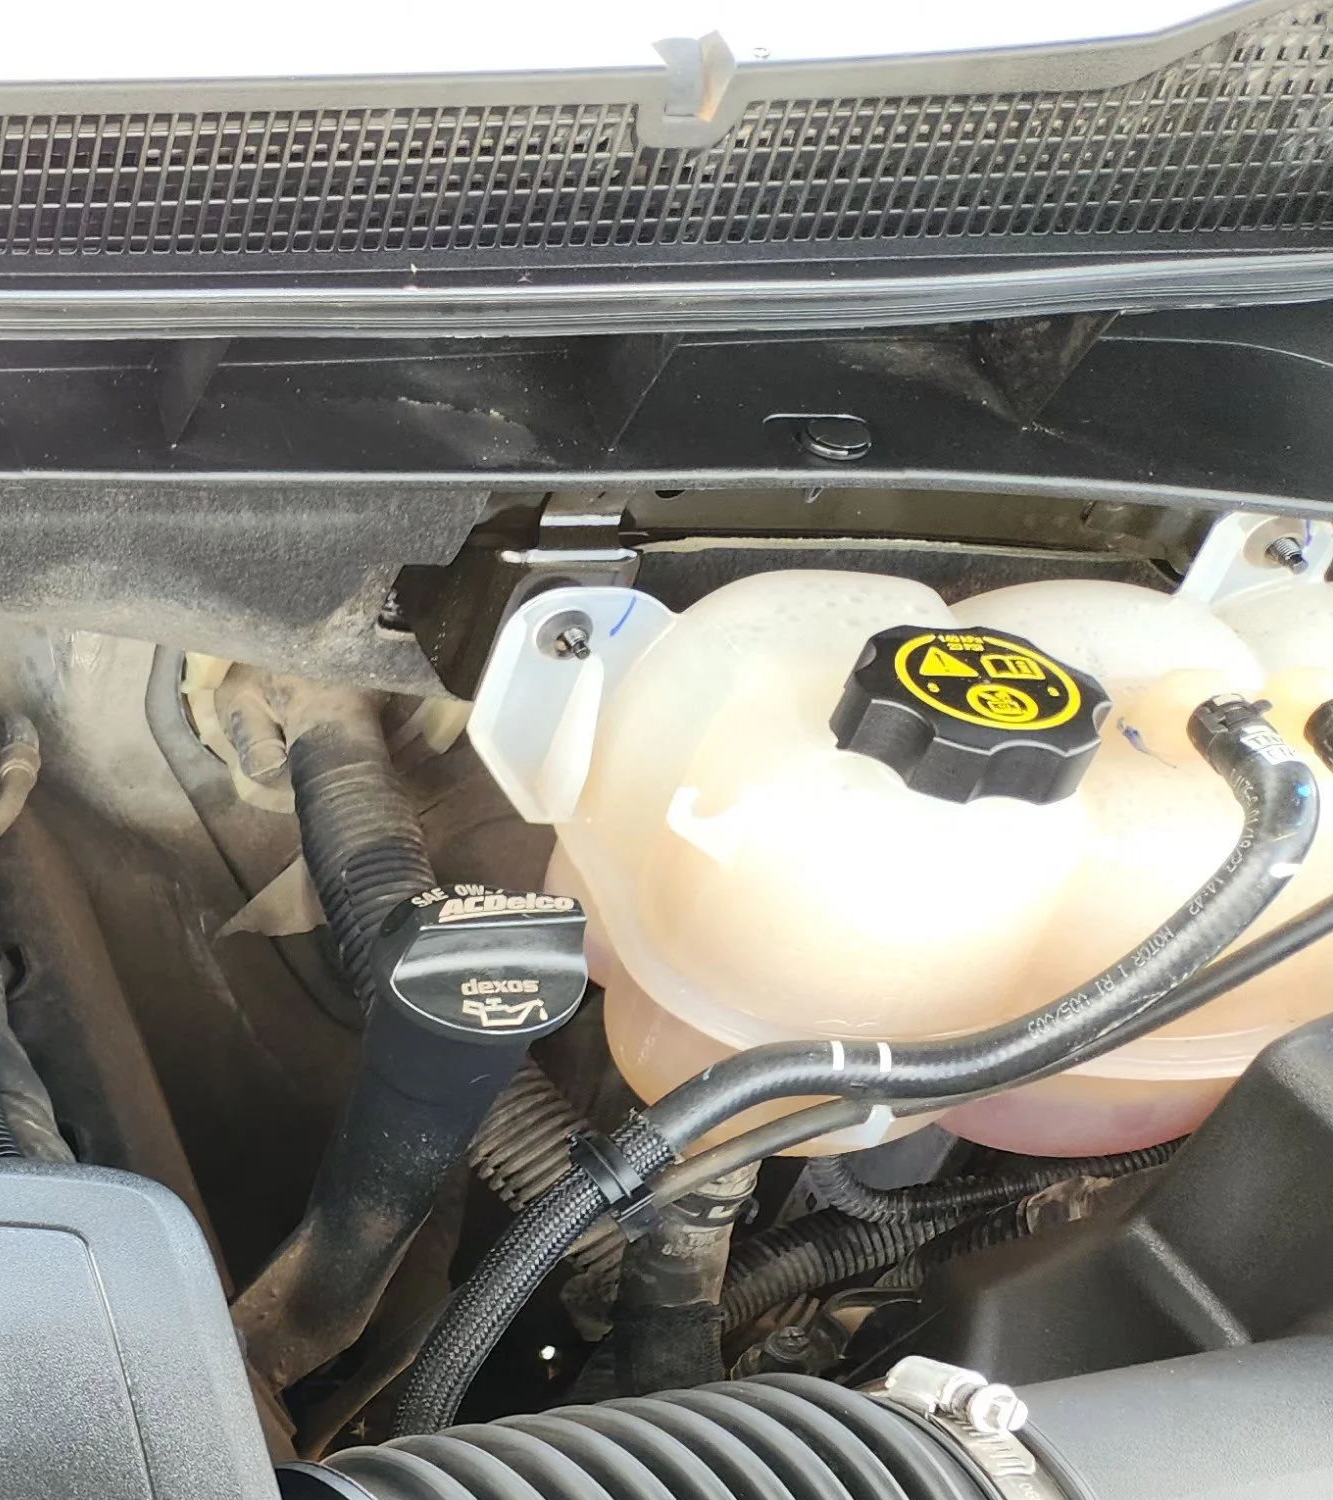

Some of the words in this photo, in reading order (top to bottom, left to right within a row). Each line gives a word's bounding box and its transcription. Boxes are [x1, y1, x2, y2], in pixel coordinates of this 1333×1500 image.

[410, 887, 450, 908] SAE
[439, 893, 576, 920] ACDelco
[1131, 927, 1176, 967] MOTOR
[460, 977, 540, 997] dexos
